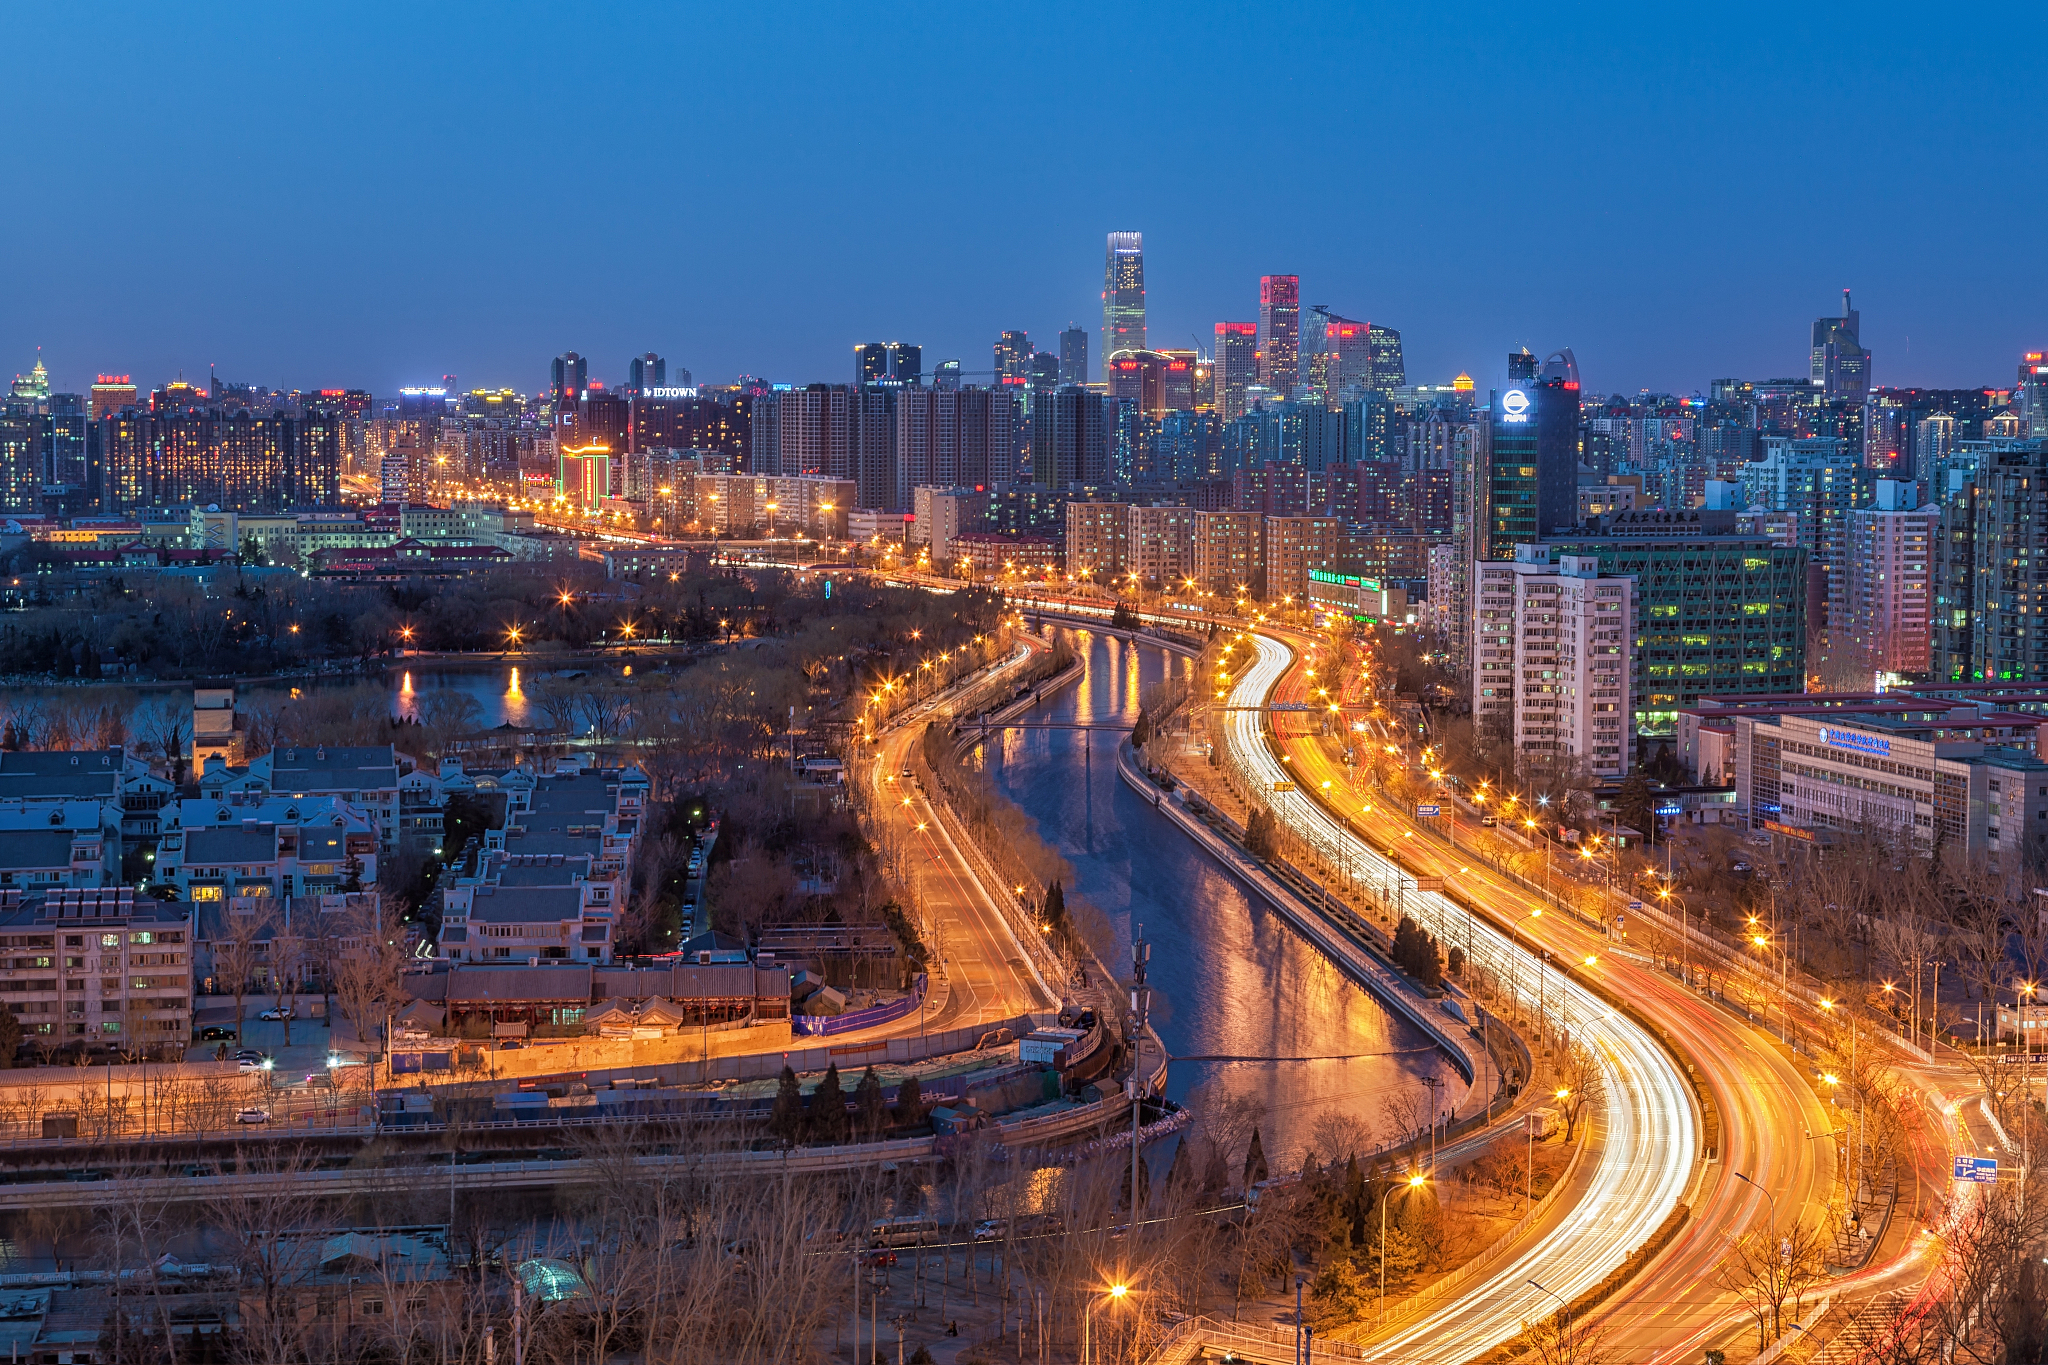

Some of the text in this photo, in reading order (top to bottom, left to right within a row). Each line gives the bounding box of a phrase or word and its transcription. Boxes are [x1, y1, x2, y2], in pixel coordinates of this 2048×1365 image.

[643, 387, 697, 397] MIDTOWN
[1615, 511, 1700, 524] 人民卫生出版社
